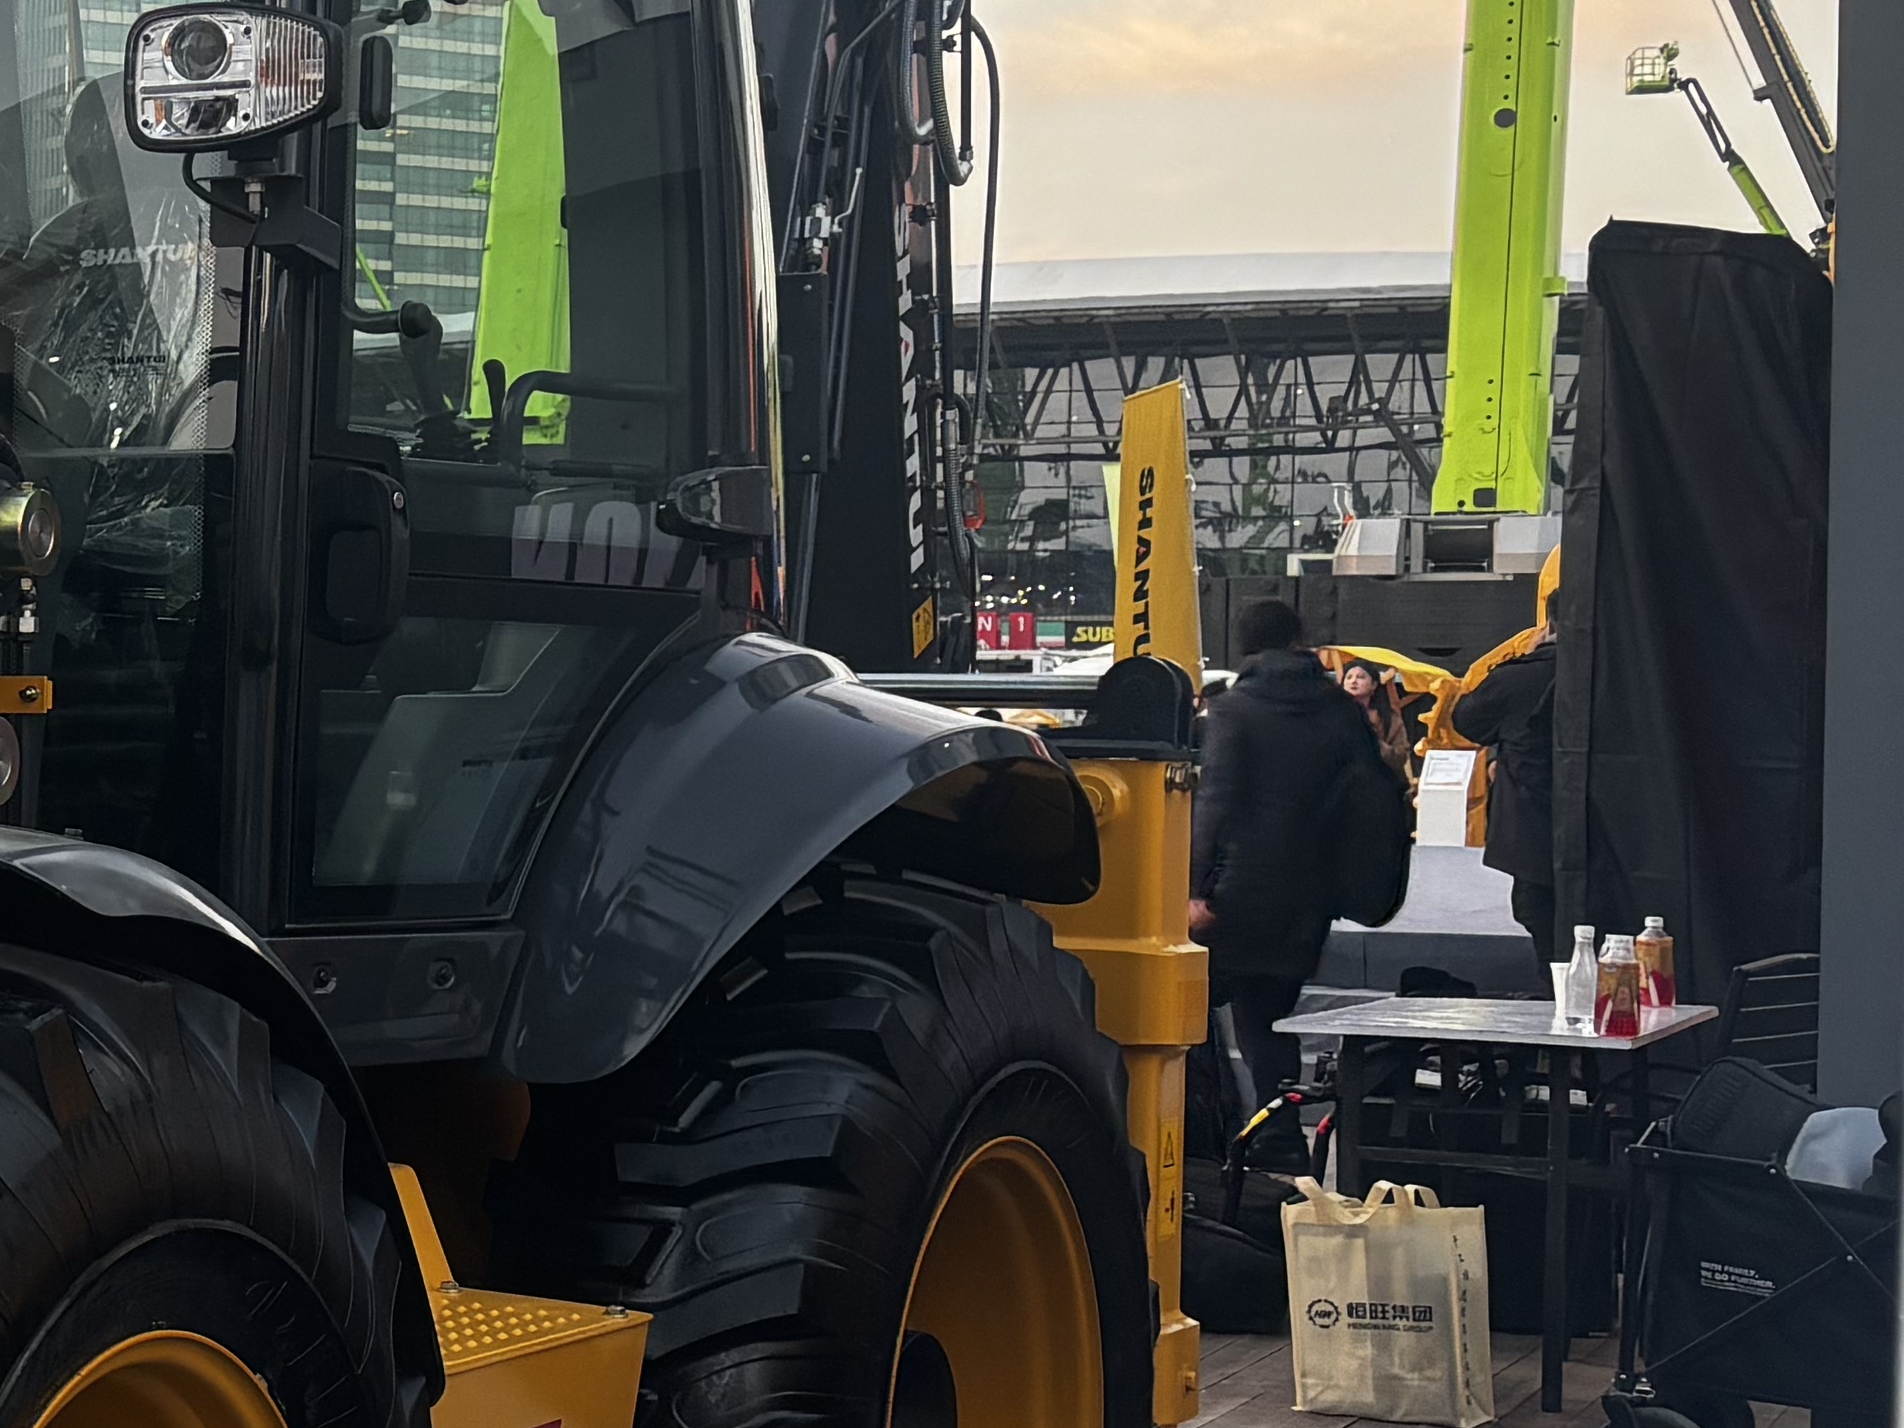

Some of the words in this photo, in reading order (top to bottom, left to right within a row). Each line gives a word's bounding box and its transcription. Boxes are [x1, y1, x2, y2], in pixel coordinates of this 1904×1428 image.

[894, 202, 925, 575] SHANTUI
[1347, 1302, 1433, 1322] 恒旺集团
